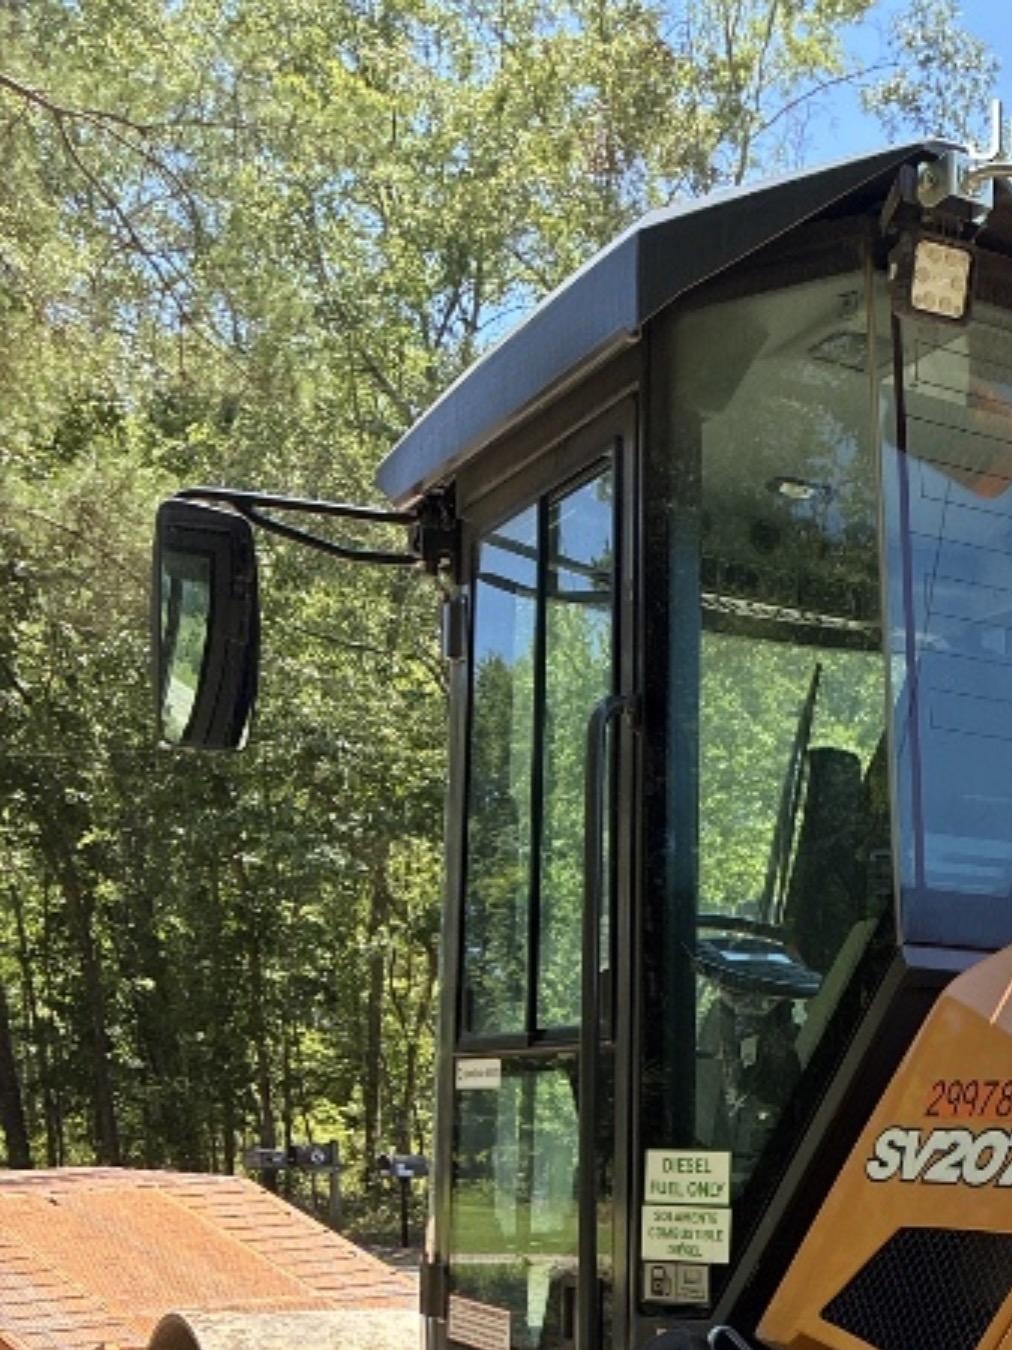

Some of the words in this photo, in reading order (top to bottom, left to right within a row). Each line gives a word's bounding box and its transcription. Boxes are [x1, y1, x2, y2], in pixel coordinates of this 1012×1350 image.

[662, 1157, 712, 1175] DIESEL
[650, 1181, 684, 1198] FUEL
[686, 1181, 727, 1198] ONLY
